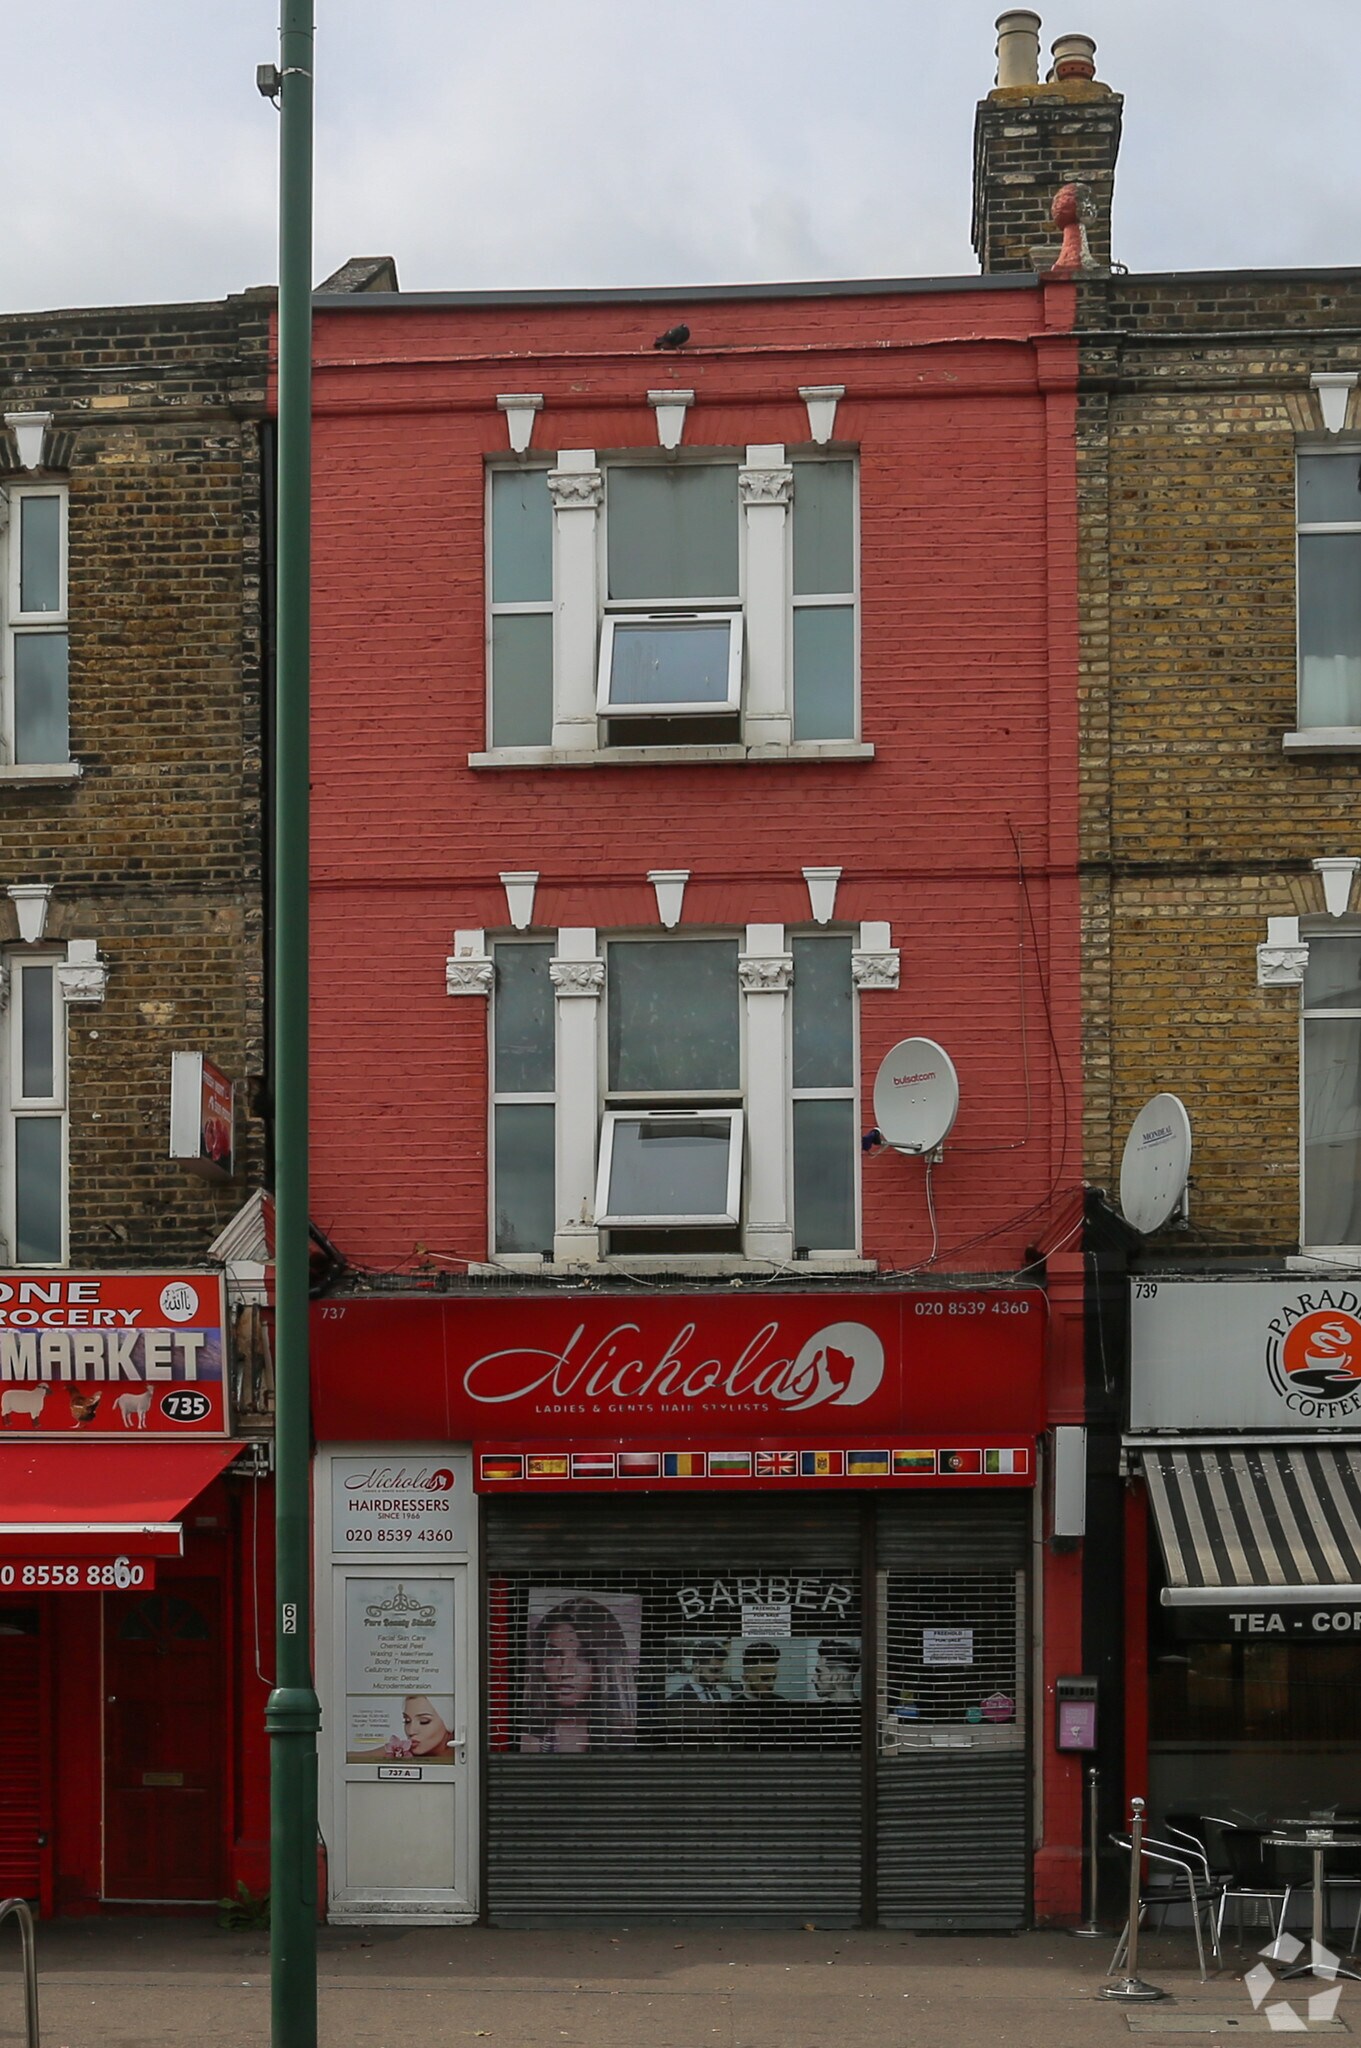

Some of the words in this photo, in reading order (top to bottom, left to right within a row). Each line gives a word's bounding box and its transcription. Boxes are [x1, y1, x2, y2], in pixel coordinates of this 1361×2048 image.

[1135, 1283, 1158, 1299] 739
[321, 1307, 346, 1320] 737
[915, 1302, 943, 1316] 020
[948, 1301, 986, 1315] 8539
[991, 1301, 1029, 1314] 4360
[0, 1332, 205, 1381] MARKET
[463, 1321, 826, 1411] Nicholas
[168, 1397, 205, 1415] 735
[535, 1404, 586, 1413] LADIES
[592, 1404, 601, 1413] &
[608, 1403, 654, 1412] GENTS
[702, 1403, 769, 1412] STYLISTS
[344, 1468, 438, 1493] Nicholas
[348, 1499, 450, 1511] HAIRDRESSERS
[377, 1512, 400, 1520] SINCE
[402, 1512, 421, 1520] 1966
[345, 1529, 373, 1541] 020
[377, 1529, 413, 1541] 8539
[417, 1529, 453, 1541] 4360
[22, 1565, 79, 1585] 8558
[86, 1556, 144, 1588] 8860
[676, 1576, 852, 1620] BARBER
[1229, 1613, 1286, 1632] TEA
